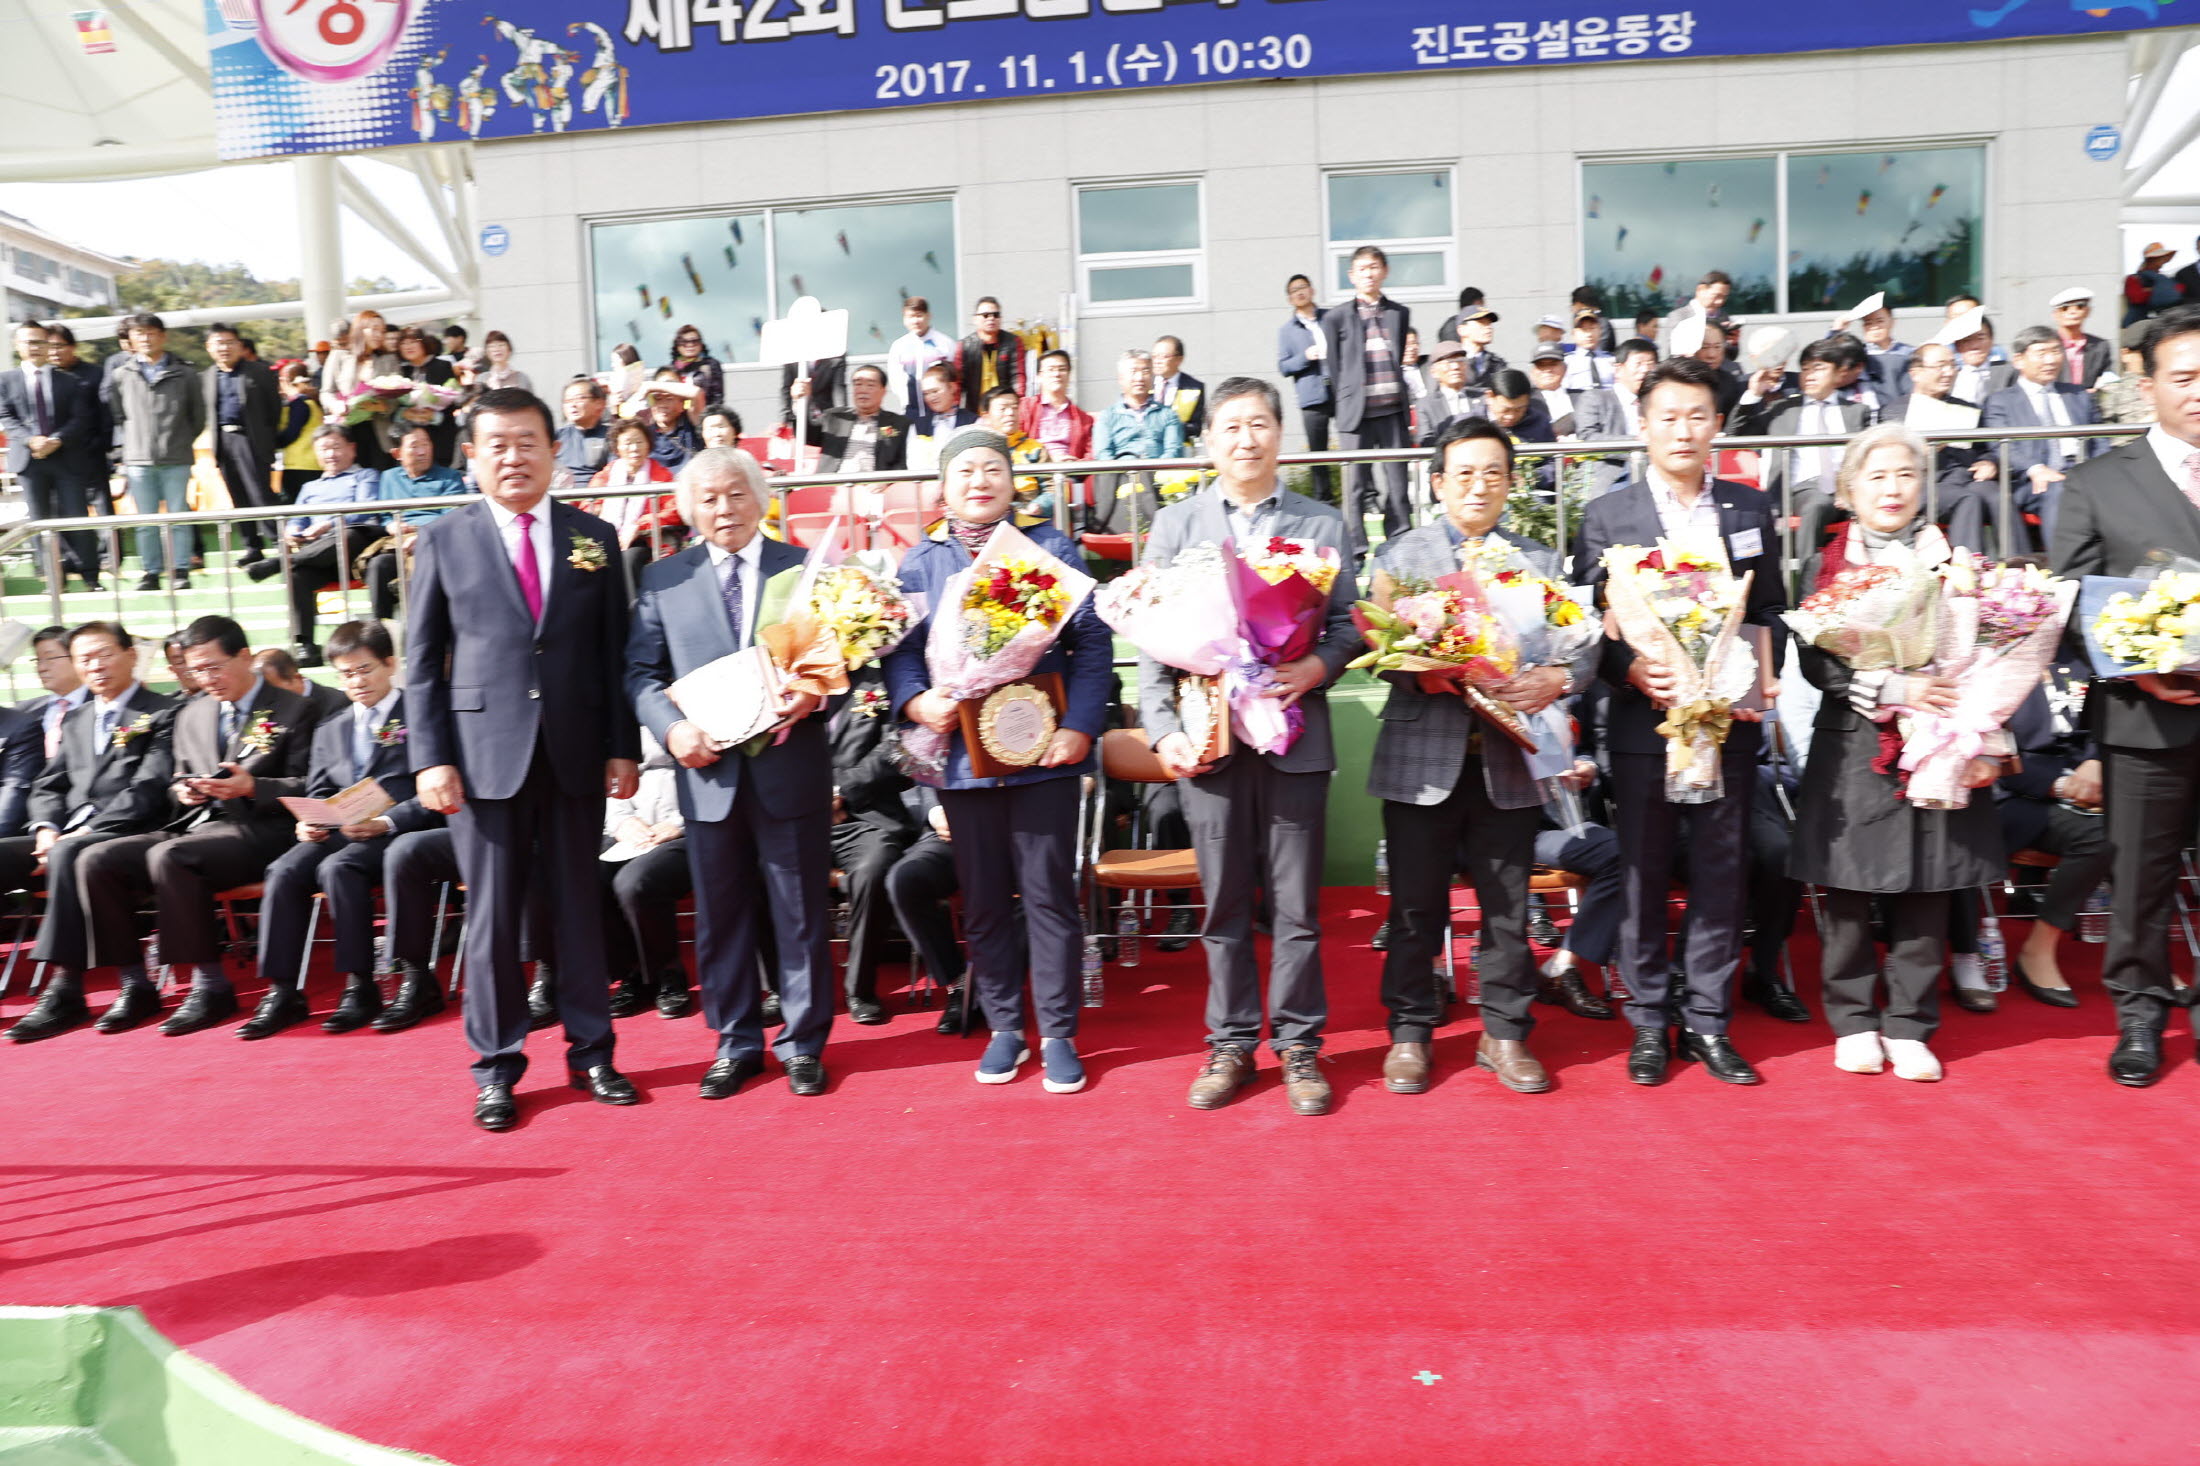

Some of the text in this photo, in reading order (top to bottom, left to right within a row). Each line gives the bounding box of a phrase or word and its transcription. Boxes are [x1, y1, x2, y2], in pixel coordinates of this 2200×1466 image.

[876, 60, 986, 99] 2017.
[1000, 54, 1055, 89] 11.
[1191, 33, 1312, 76] 10:30
[1411, 11, 1696, 64] 진도공설운동장
